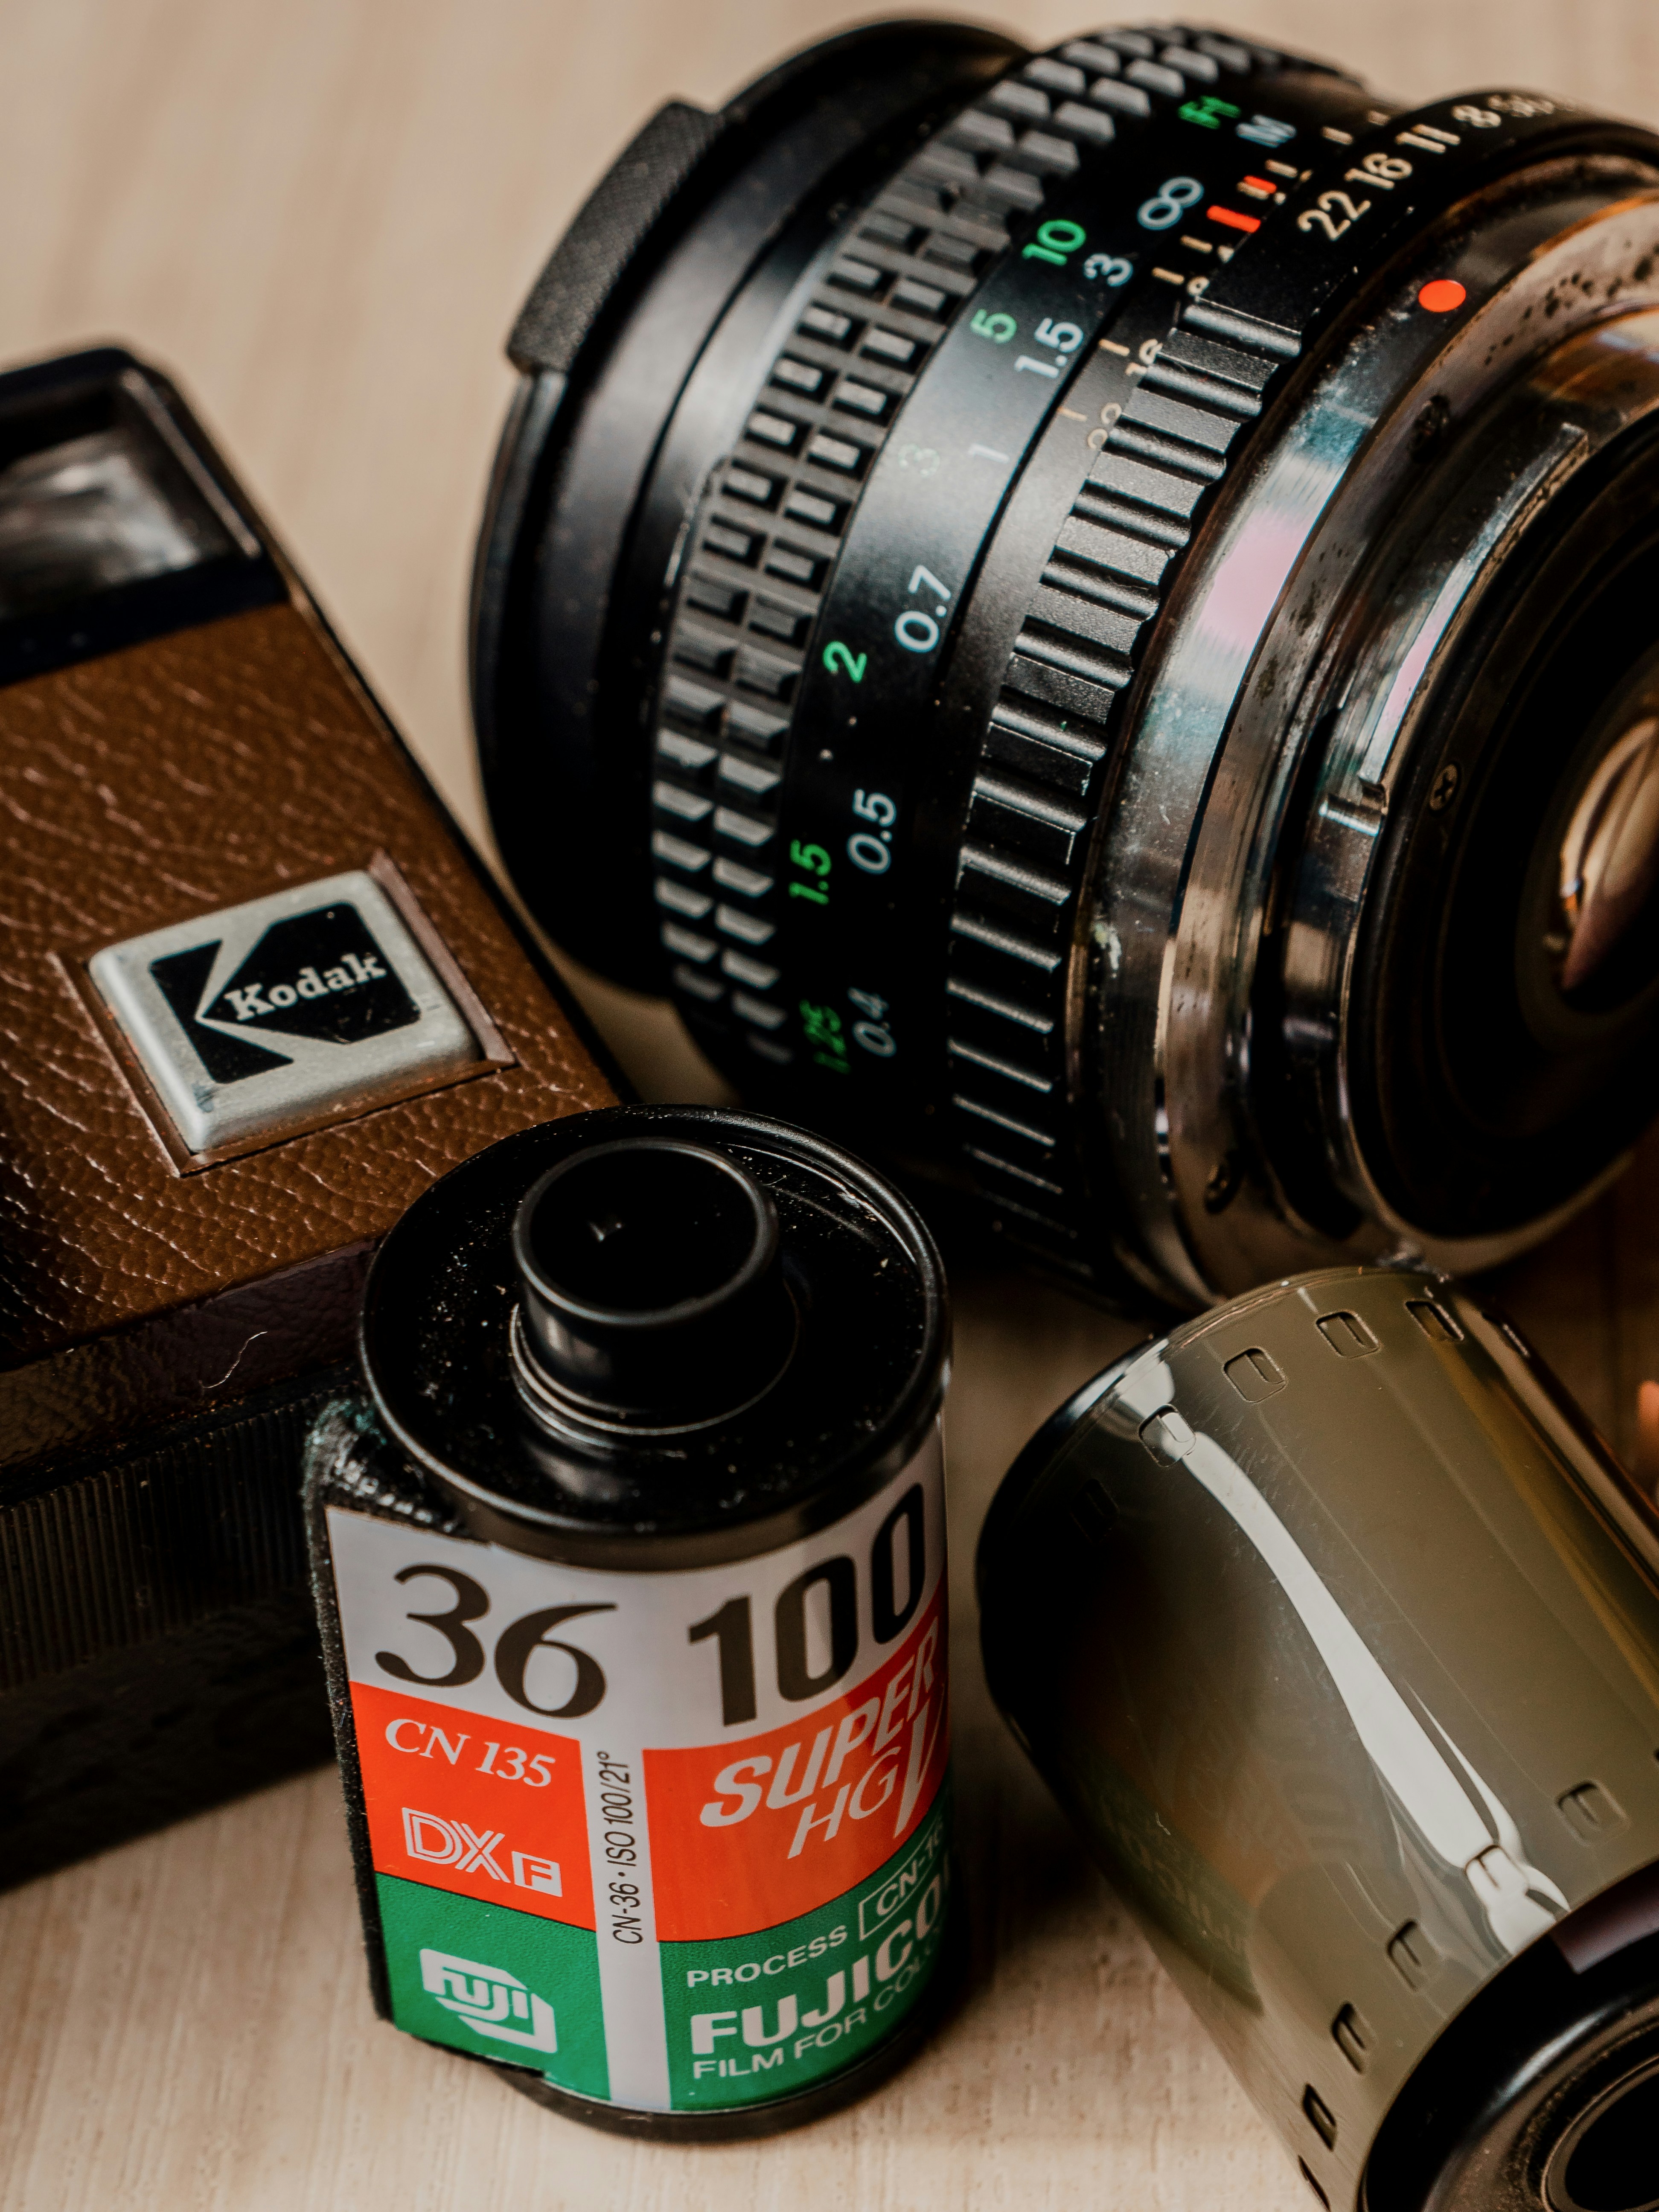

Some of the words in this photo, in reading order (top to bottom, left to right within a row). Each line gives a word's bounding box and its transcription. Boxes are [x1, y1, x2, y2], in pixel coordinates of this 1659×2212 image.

[1297, 190, 1371, 241] 22
[1344, 152, 1413, 190] 16
[1395, 124, 1461, 154] 11
[1083, 253, 1133, 287] 3
[1014, 317, 1084, 378] 1.5
[967, 442, 1010, 465] 1
[788, 839, 832, 905] 1.5
[823, 640, 867, 682] 2
[898, 443, 940, 478] 3
[969, 309, 1017, 343] 5
[1022, 219, 1087, 266] 10
[894, 565, 952, 653] 0.7
[847, 789, 896, 875] 0.5
[223, 952, 387, 1022] Kodak
[847, 987, 896, 1057] 0.4
[375, 1563, 617, 1719] 36
[687, 1482, 926, 1727] 100
[385, 1718, 471, 1765] CN
[476, 1742, 556, 1787] 135
[699, 1615, 938, 1827] SUPER
[788, 1746, 902, 1859] HG
[604, 1831, 637, 1866] ISO
[687, 1925, 848, 1987] PROCESS
[420, 1952, 550, 2044] FUJI
[693, 2047, 784, 2079] FILM
[793, 2007, 868, 2059] FOR
